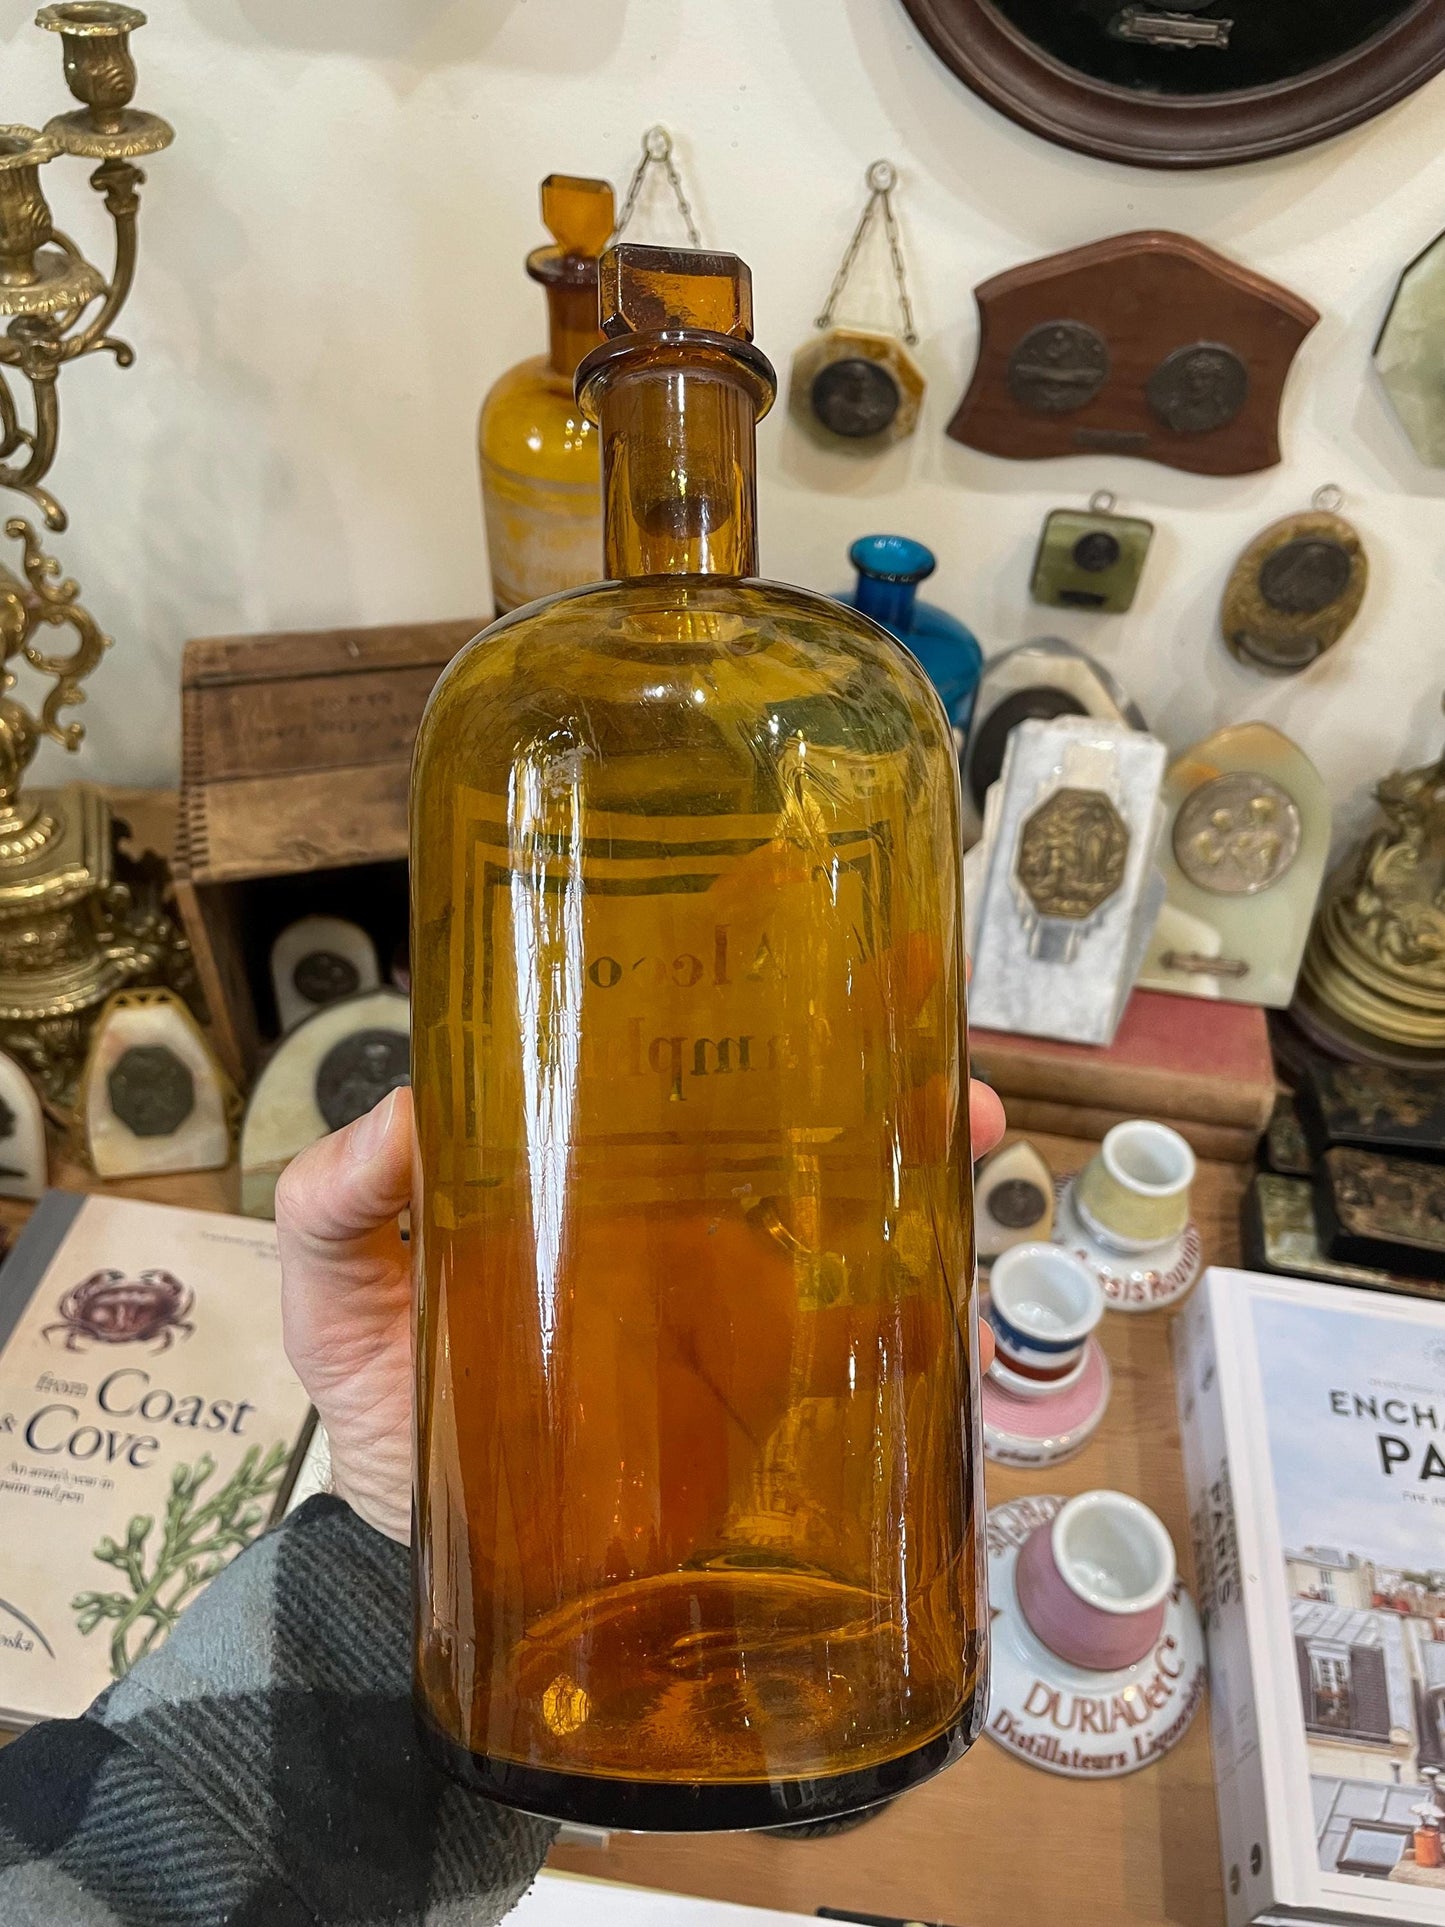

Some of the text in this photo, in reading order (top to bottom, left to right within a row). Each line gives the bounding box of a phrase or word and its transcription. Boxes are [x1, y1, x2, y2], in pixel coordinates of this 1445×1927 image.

[34, 1367, 255, 1437] from Coast
[1328, 1387, 1445, 1431] ENCH
[23, 1403, 160, 1470] Cove
